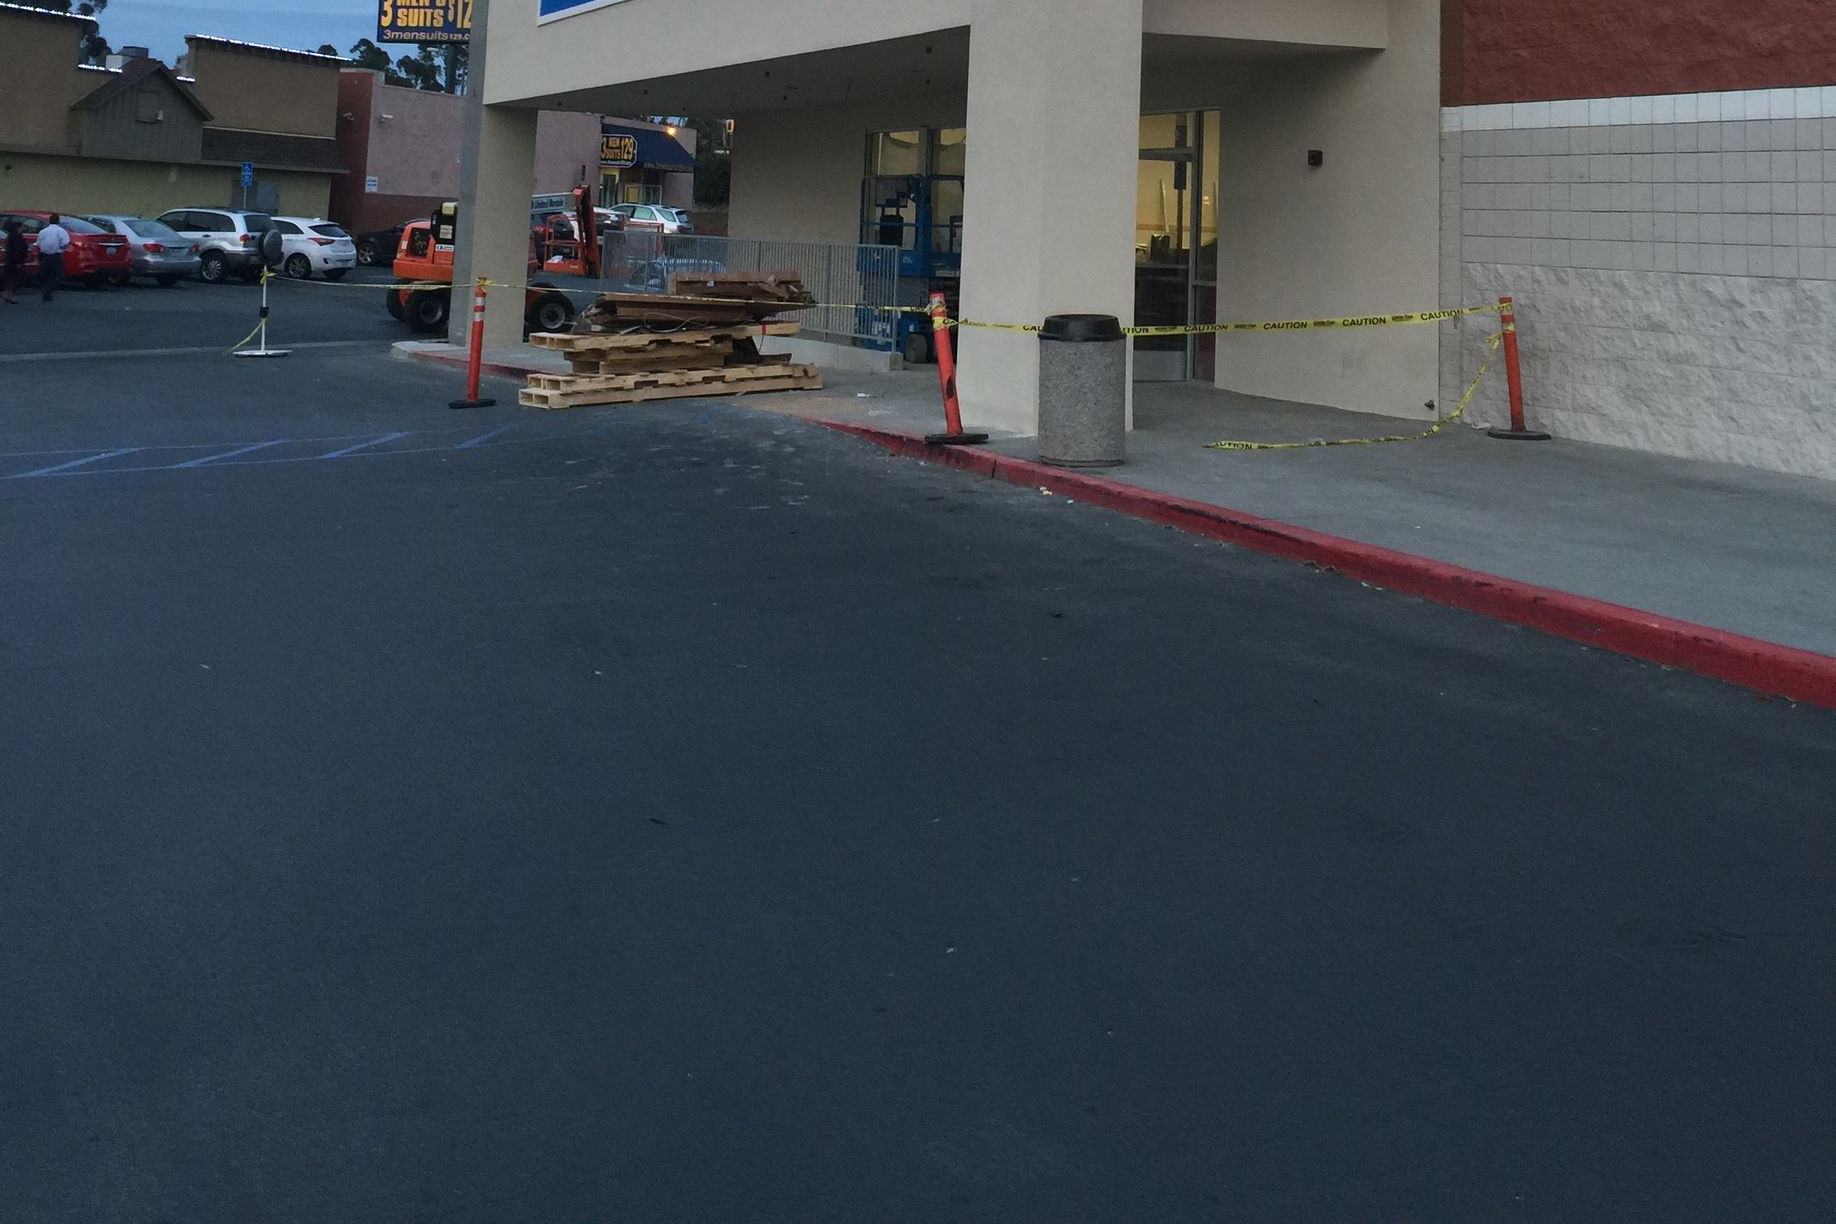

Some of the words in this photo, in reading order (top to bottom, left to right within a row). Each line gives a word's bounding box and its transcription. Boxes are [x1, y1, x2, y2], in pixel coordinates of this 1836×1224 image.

[396, 8, 444, 27] SUITS
[1420, 309, 1464, 321] CAUTION
[1262, 321, 1308, 331] CAUTION
[1341, 317, 1387, 327] CAUTION
[1183, 324, 1229, 333] CAUTION
